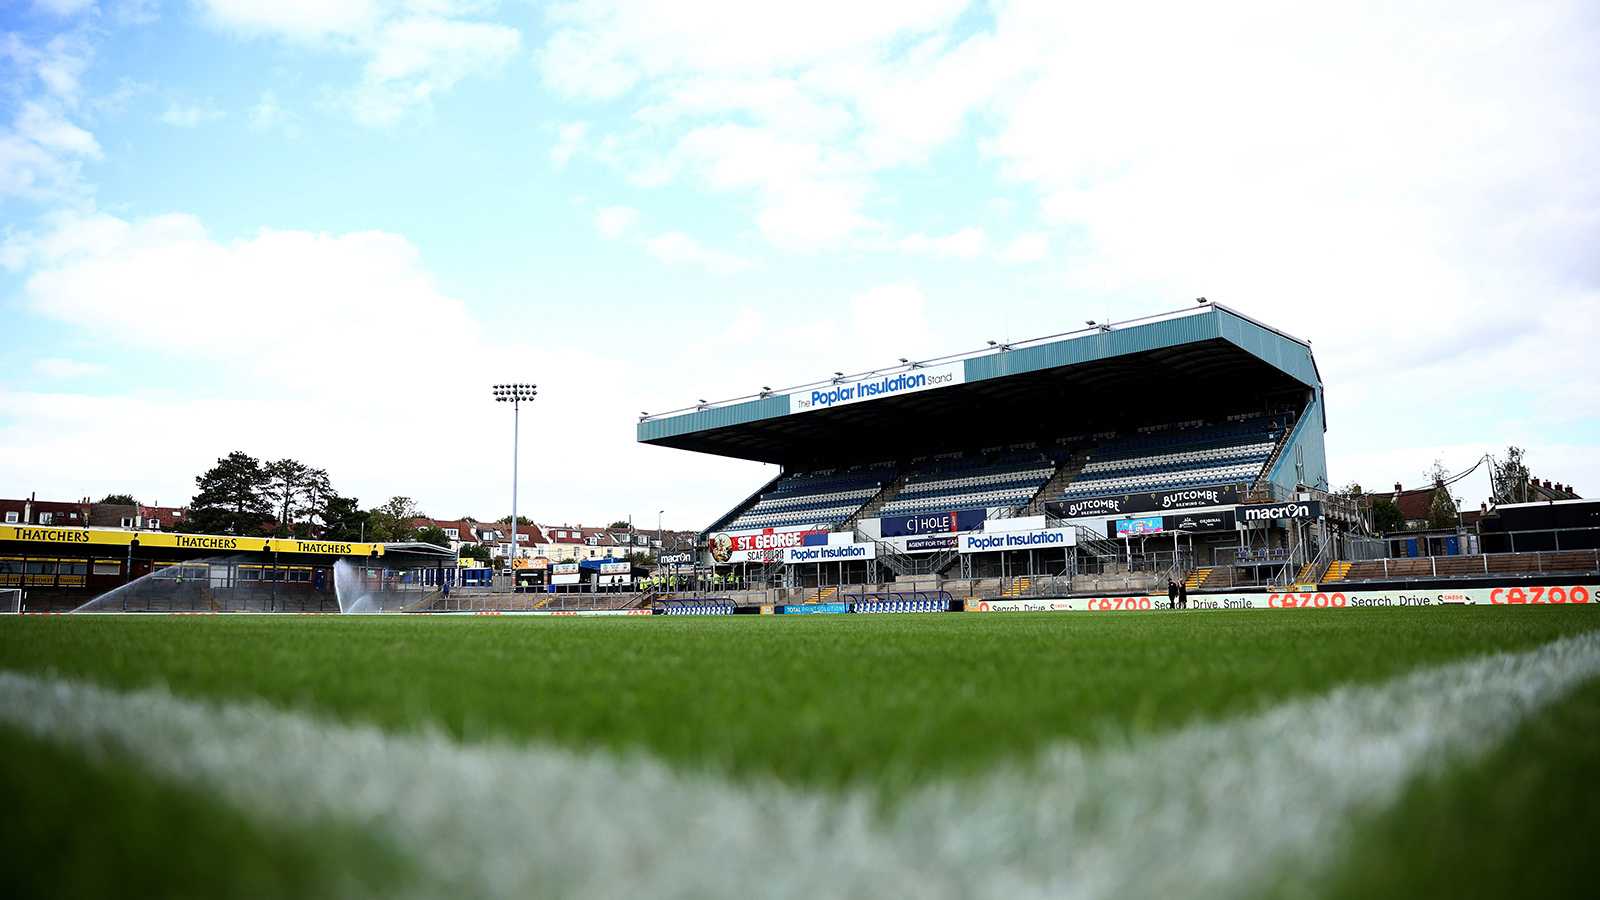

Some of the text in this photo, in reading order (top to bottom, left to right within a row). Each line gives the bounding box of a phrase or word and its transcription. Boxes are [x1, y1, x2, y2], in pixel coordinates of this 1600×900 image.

[798, 373, 952, 408] The Poplar Insulation Stand
[1164, 490, 1219, 507] BUTCOMBE
[1069, 500, 1120, 515] BUTCOMBE
[1245, 504, 1309, 520] macron
[921, 517, 949, 529] HOLE
[14, 527, 90, 543] THATCHERS
[175, 535, 237, 549] THATCHERS
[737, 532, 802, 550] ST. GEORGE
[968, 531, 1064, 550] Poplar Insulation
[296, 541, 352, 554] THATCHERS
[791, 545, 866, 561] Poplar Insulation
[660, 552, 691, 564] macron
[1268, 592, 1347, 608] CAZOO
[1490, 586, 1590, 605] CAZOO
[1088, 597, 1151, 611] CAZOO
